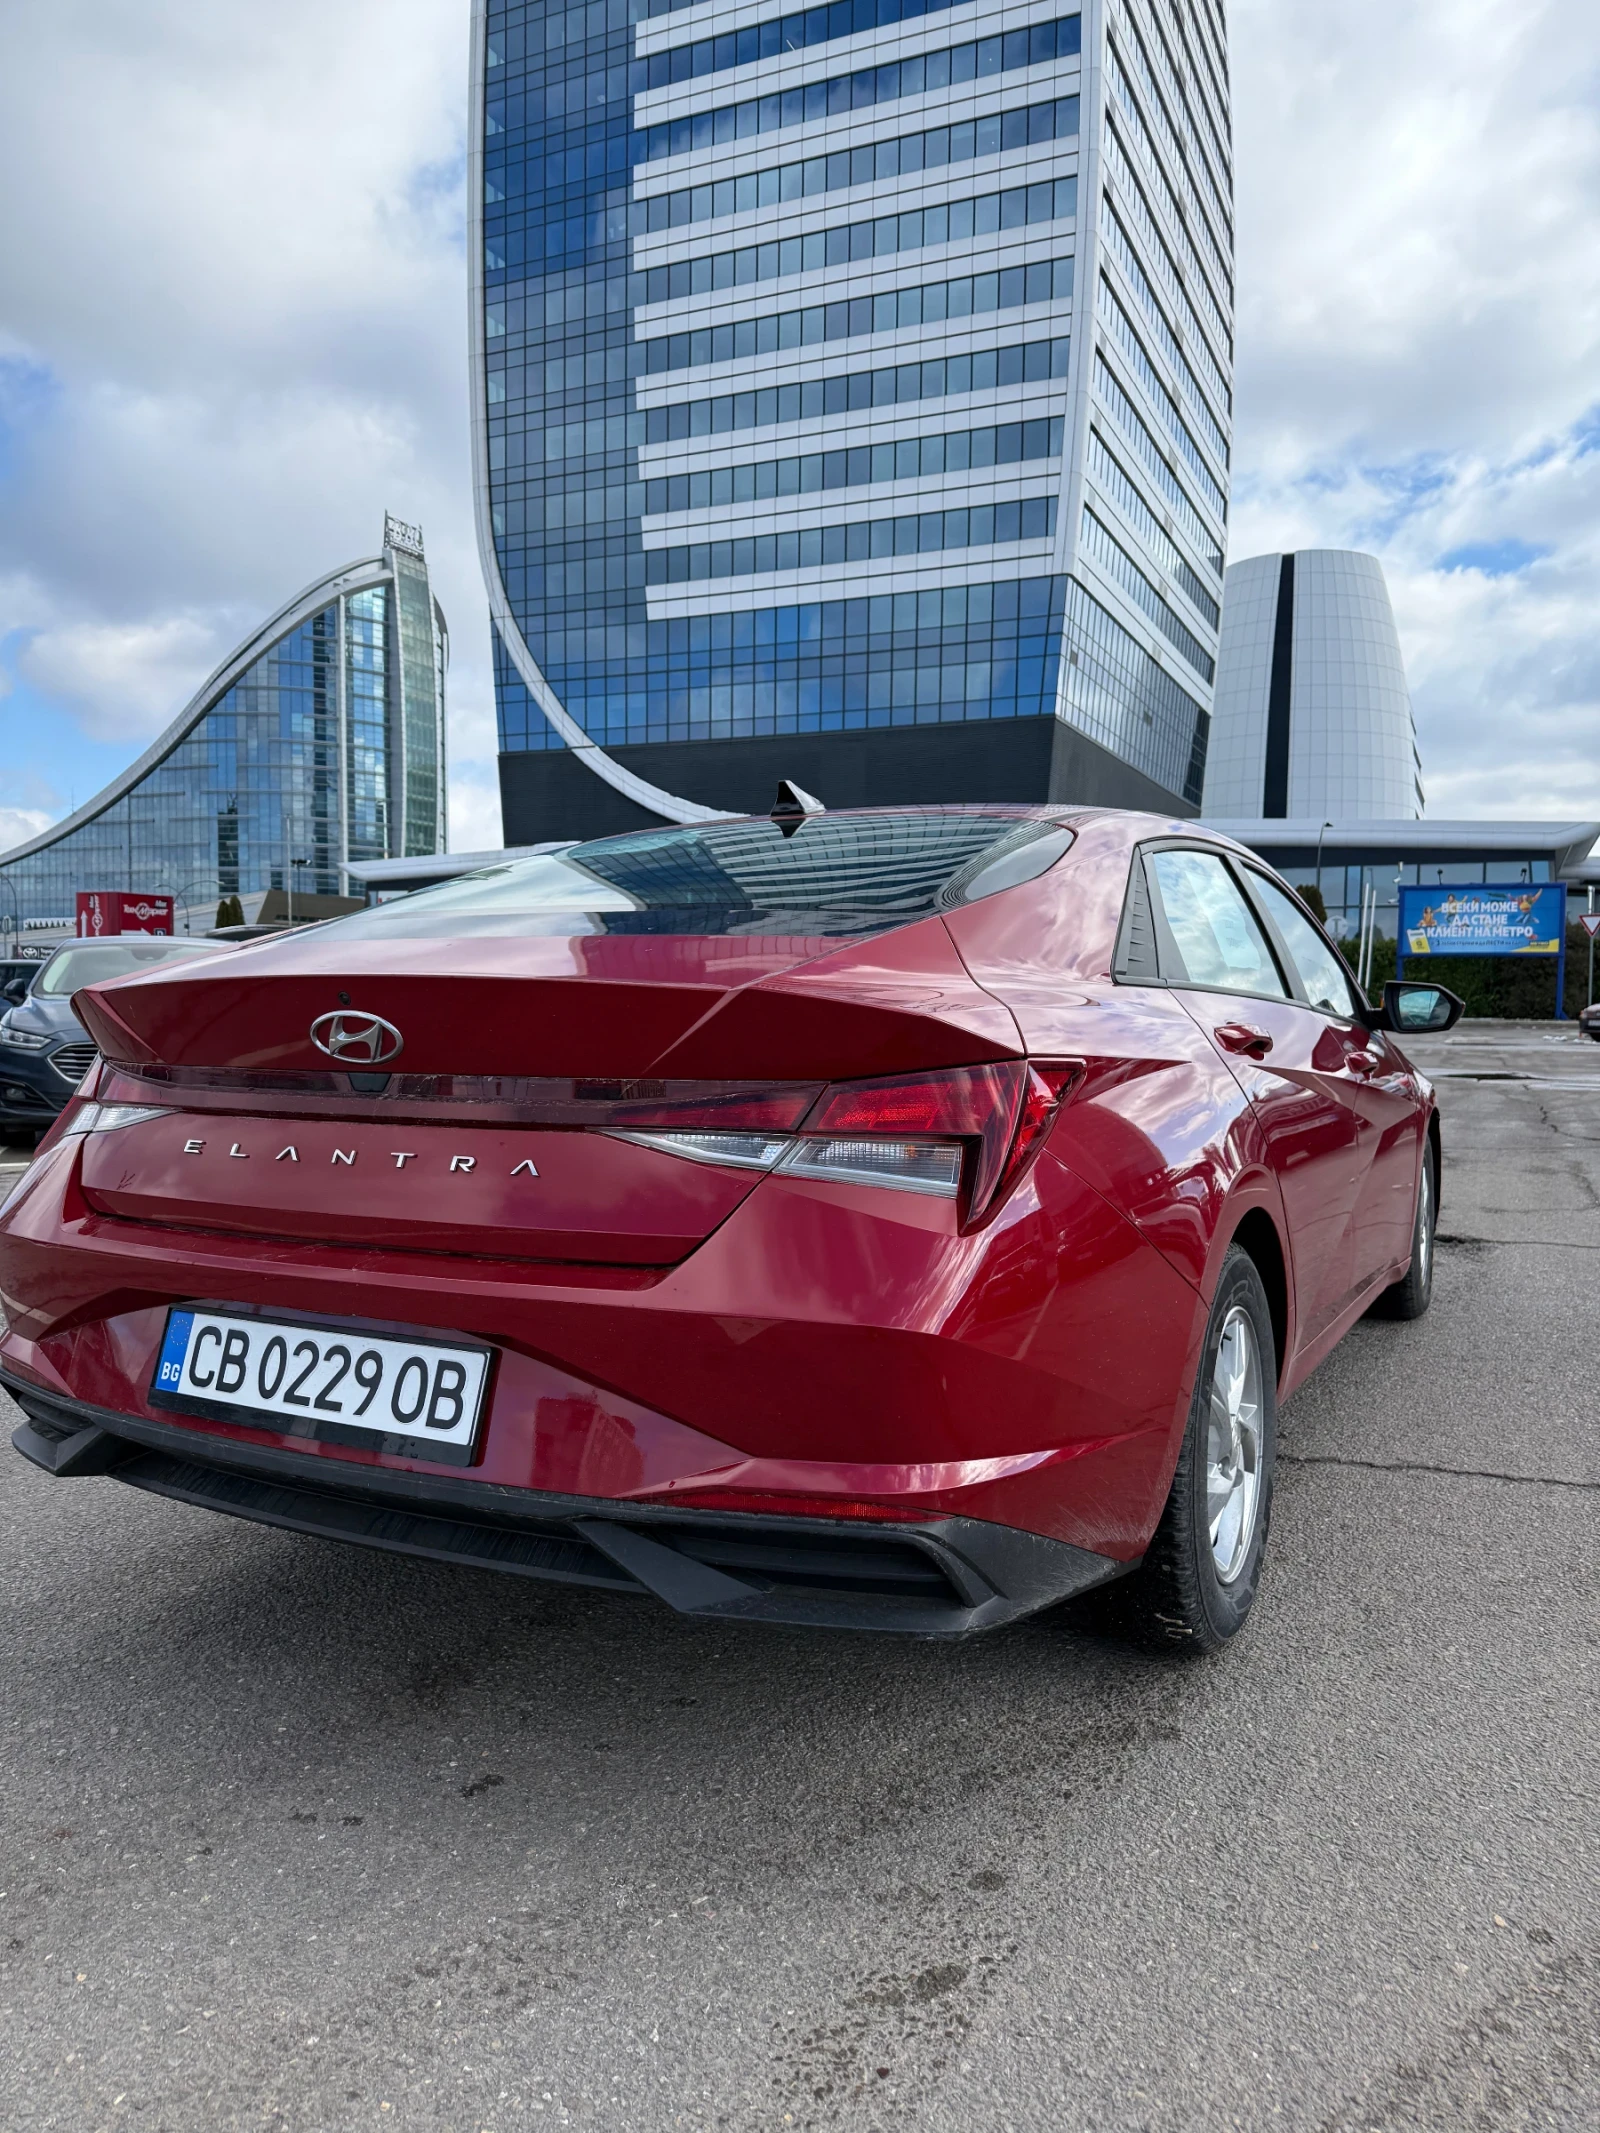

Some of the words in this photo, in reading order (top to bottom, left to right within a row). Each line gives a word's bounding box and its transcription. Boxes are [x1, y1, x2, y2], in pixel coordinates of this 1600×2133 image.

[1441, 901, 1479, 913] ВСЕКИ
[1480, 901, 1518, 912] МОЖЕ
[1451, 914, 1470, 927] ДА
[1471, 914, 1508, 925] СТАНЕ
[1427, 927, 1472, 938] КЛИЕНТ
[1474, 926, 1492, 938] НА
[1492, 926, 1533, 937] МЕТРО
[183, 1139, 541, 1178] ELANTRA
[161, 1362, 181, 1383] BG
[188, 1326, 250, 1394] CB
[258, 1335, 384, 1416] 0229
